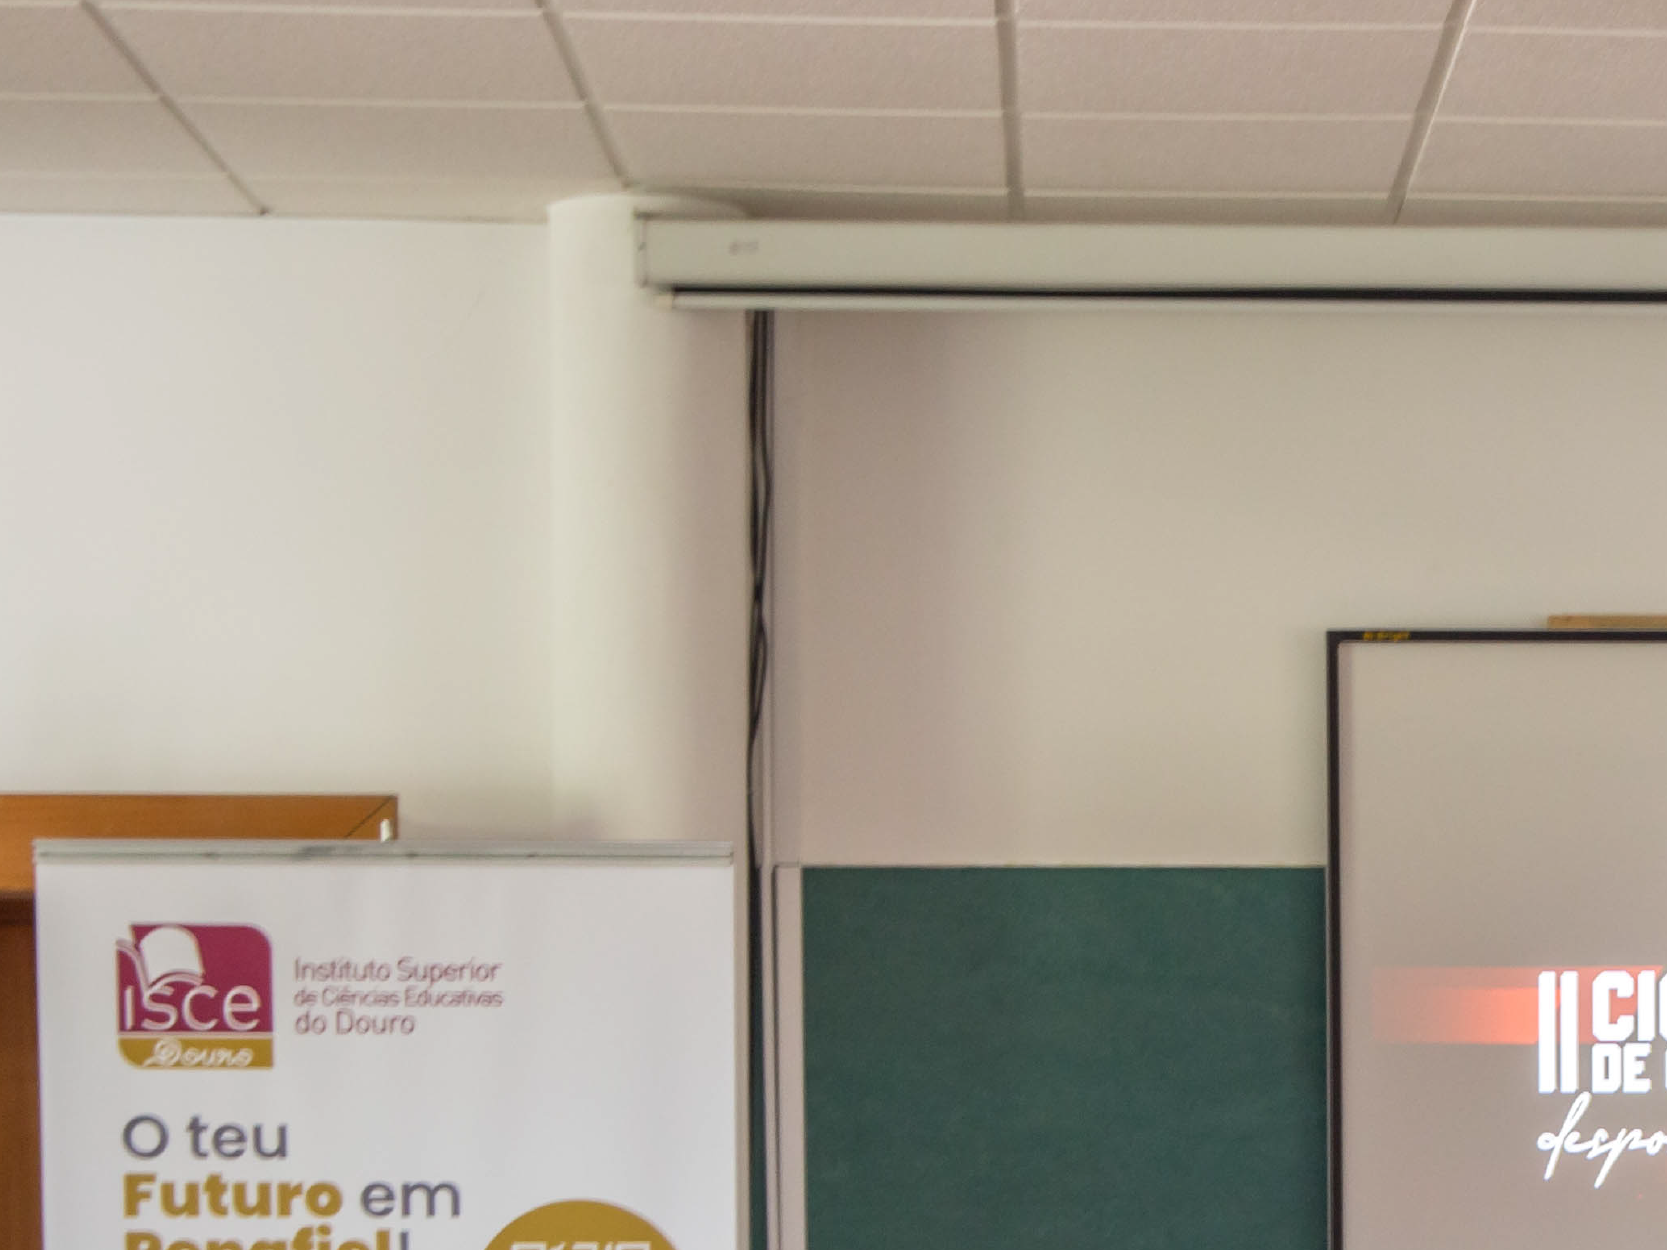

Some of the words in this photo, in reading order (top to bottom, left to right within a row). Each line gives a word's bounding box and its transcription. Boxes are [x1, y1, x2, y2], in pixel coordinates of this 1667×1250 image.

[294, 956, 391, 982] Instituto
[397, 956, 502, 987] Superior
[294, 985, 318, 1008] de
[404, 985, 504, 1008] Educativas
[295, 1011, 327, 1035] do
[335, 1009, 415, 1035] Douro
[1537, 970, 1579, 1094] II
[1591, 1041, 1652, 1094] DE
[123, 1114, 169, 1159] O
[186, 1115, 289, 1159] teu
[122, 1173, 343, 1219] Futuro
[360, 1181, 461, 1218] em
